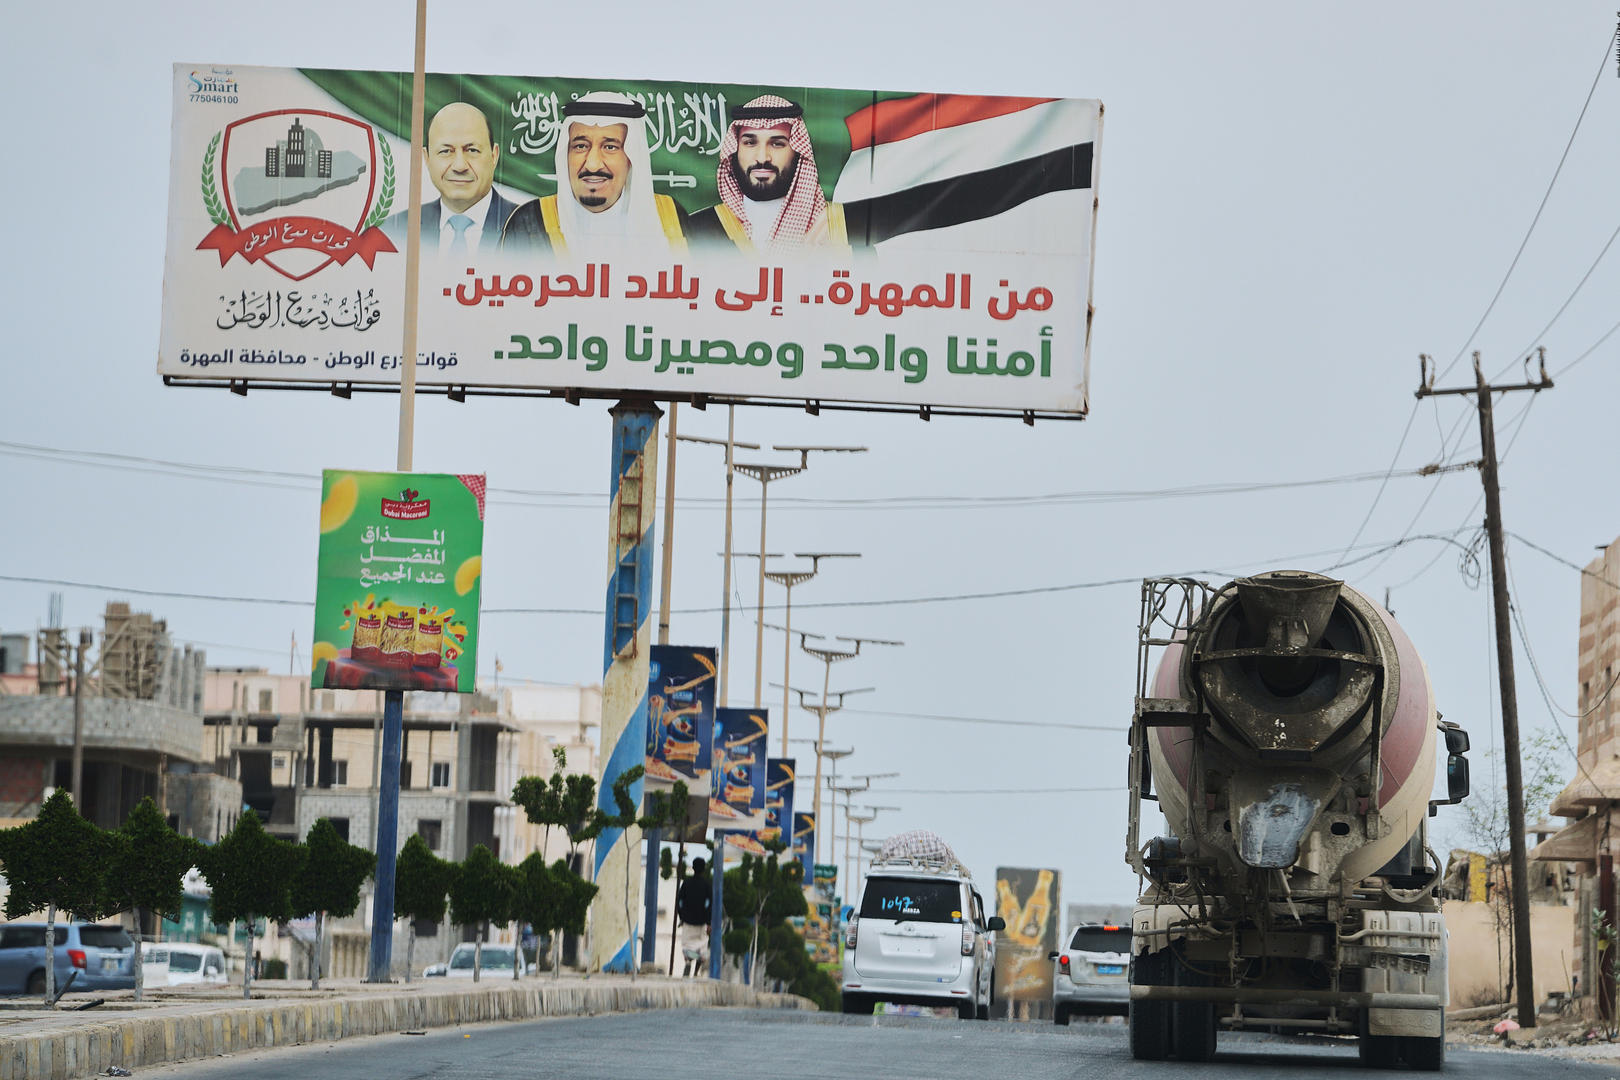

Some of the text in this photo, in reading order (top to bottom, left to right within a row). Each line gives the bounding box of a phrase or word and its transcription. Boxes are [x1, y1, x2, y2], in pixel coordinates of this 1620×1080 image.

[188, 70, 238, 93] Smart
[190, 94, 239, 104] 775046100
[442, 263, 610, 307] الحرمين.
[625, 264, 700, 310] بلاد
[714, 267, 784, 317] إلى
[988, 279, 1054, 321] من
[180, 348, 234, 367] المهرة
[239, 348, 307, 365] محافظة
[325, 350, 375, 369] الوطن
[380, 355, 403, 369] رع
[494, 323, 1053, 385] أمننا واحد ومصيرنا واحد.
[360, 525, 445, 546] المذاق
[360, 545, 446, 566] المفضل
[360, 563, 446, 588] عند الجميع
[881, 896, 914, 912] 1047
